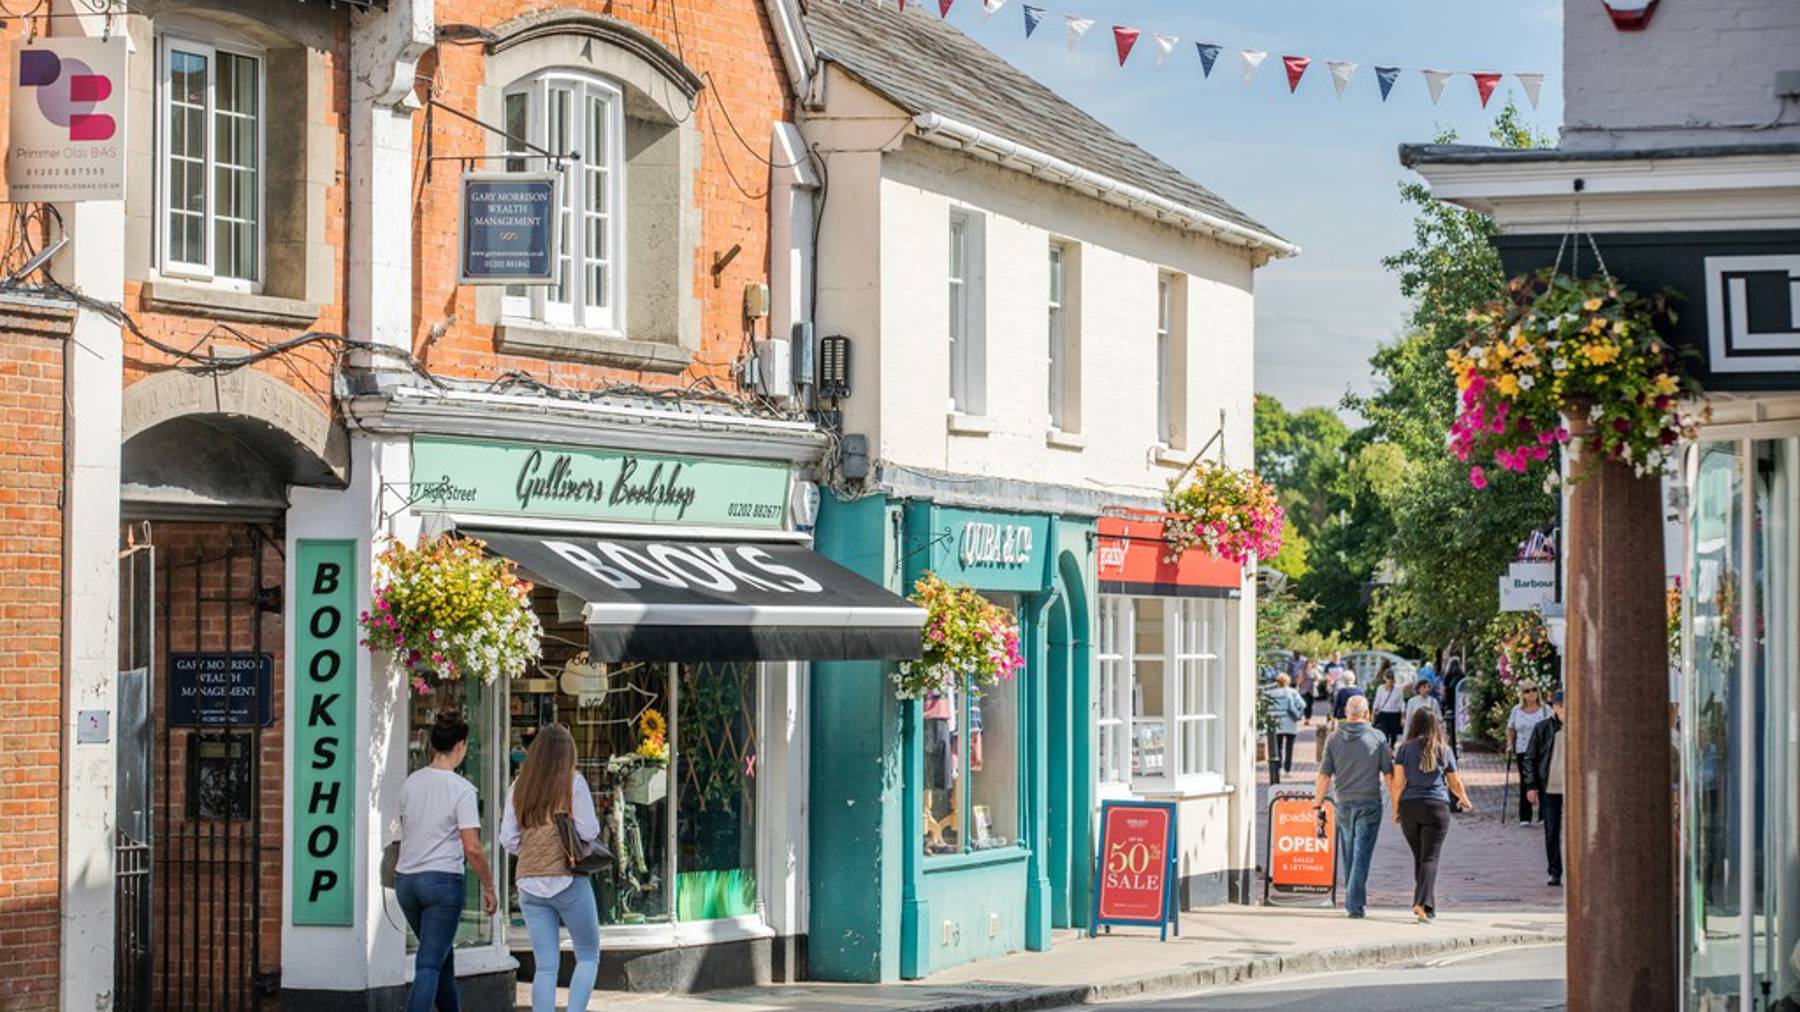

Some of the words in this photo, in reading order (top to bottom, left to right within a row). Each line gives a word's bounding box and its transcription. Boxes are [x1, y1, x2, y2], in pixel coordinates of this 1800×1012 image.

[16, 148, 61, 160] Primmer
[63, 147, 89, 159] Olds
[91, 146, 117, 158] BAS
[26, 168, 60, 176] 01202
[471, 192, 497, 201] GARY
[498, 192, 548, 201] MORRISON
[488, 204, 529, 214] WEALTH
[474, 217, 542, 226] MANAGEMENT
[448, 484, 477, 501] Street
[515, 450, 604, 510] Gullivers
[608, 456, 695, 521] Bookshop
[727, 502, 752, 518] 01202
[540, 540, 823, 592] BOOKS
[1513, 578, 1555, 589] Barbour
[206, 660, 263, 670] MORISO
[307, 561, 341, 903] BOOKSHOP
[1279, 836, 1329, 853] OPEN
[1106, 873, 1160, 890] SALE
